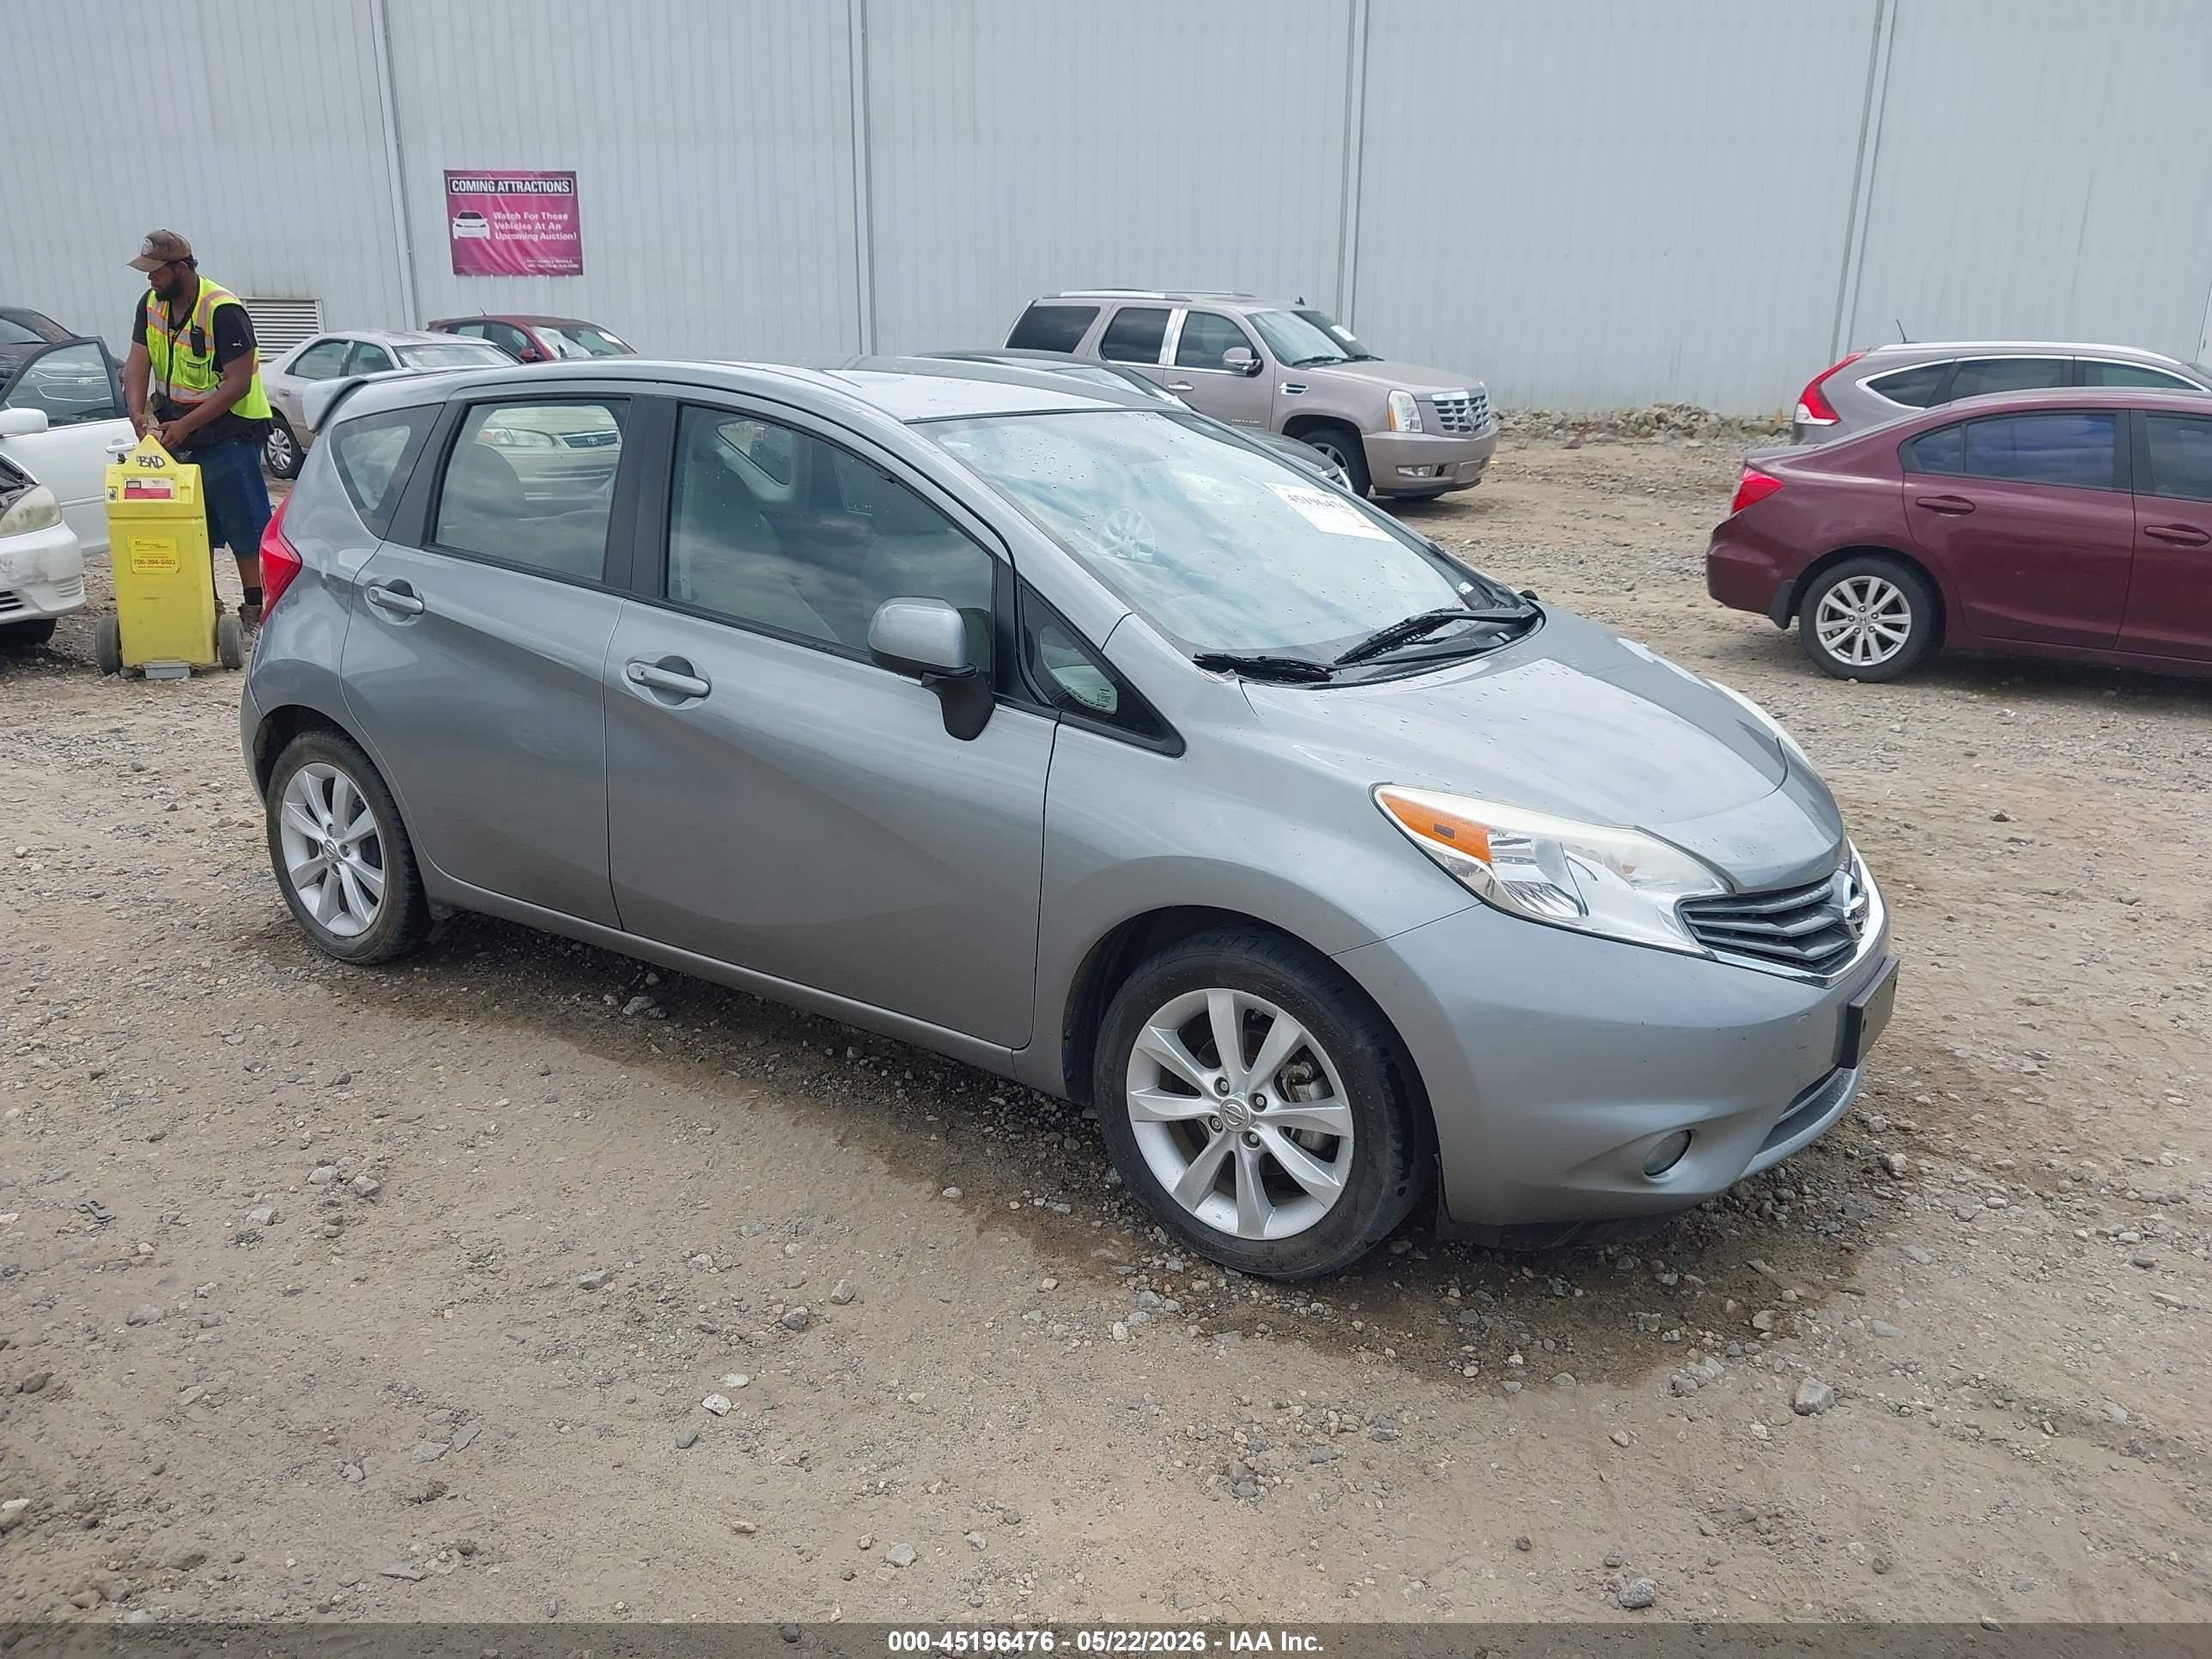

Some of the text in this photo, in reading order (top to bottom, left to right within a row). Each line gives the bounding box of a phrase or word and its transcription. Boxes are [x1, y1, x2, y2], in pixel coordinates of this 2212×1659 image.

[452, 180, 569, 192] COMING ATTRACTIONS
[495, 222, 532, 230] Vehicles
[495, 232, 538, 241] Upcoming
